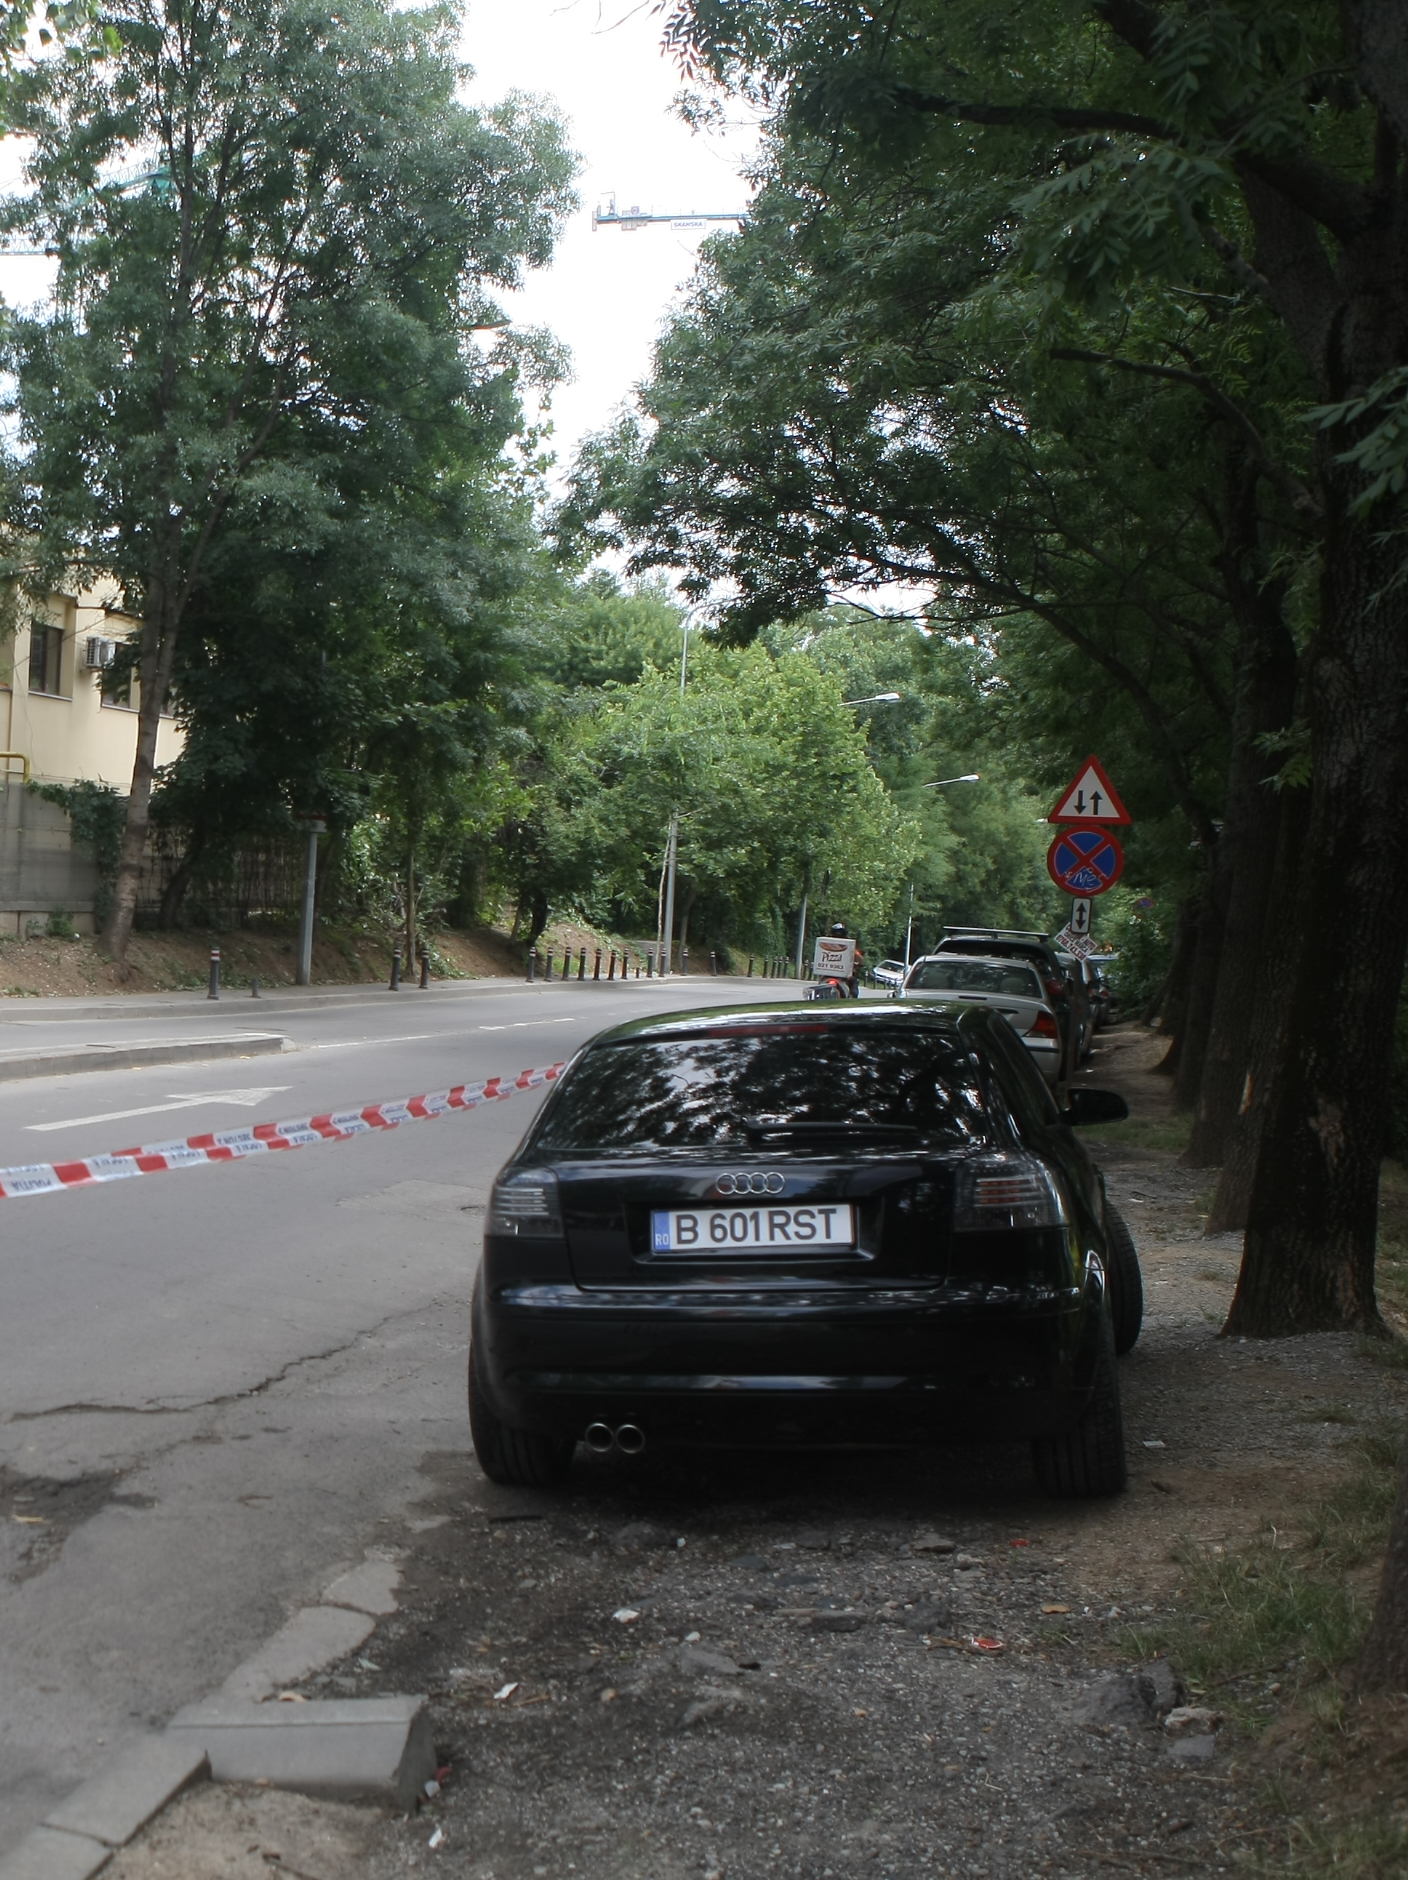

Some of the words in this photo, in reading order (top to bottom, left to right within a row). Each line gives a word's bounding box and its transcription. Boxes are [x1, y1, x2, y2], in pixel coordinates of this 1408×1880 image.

[822, 951, 842, 962] Pizza
[676, 1213, 699, 1245] B
[709, 1210, 760, 1243] 601
[768, 1208, 837, 1242] RST
[655, 1233, 670, 1246] RO
